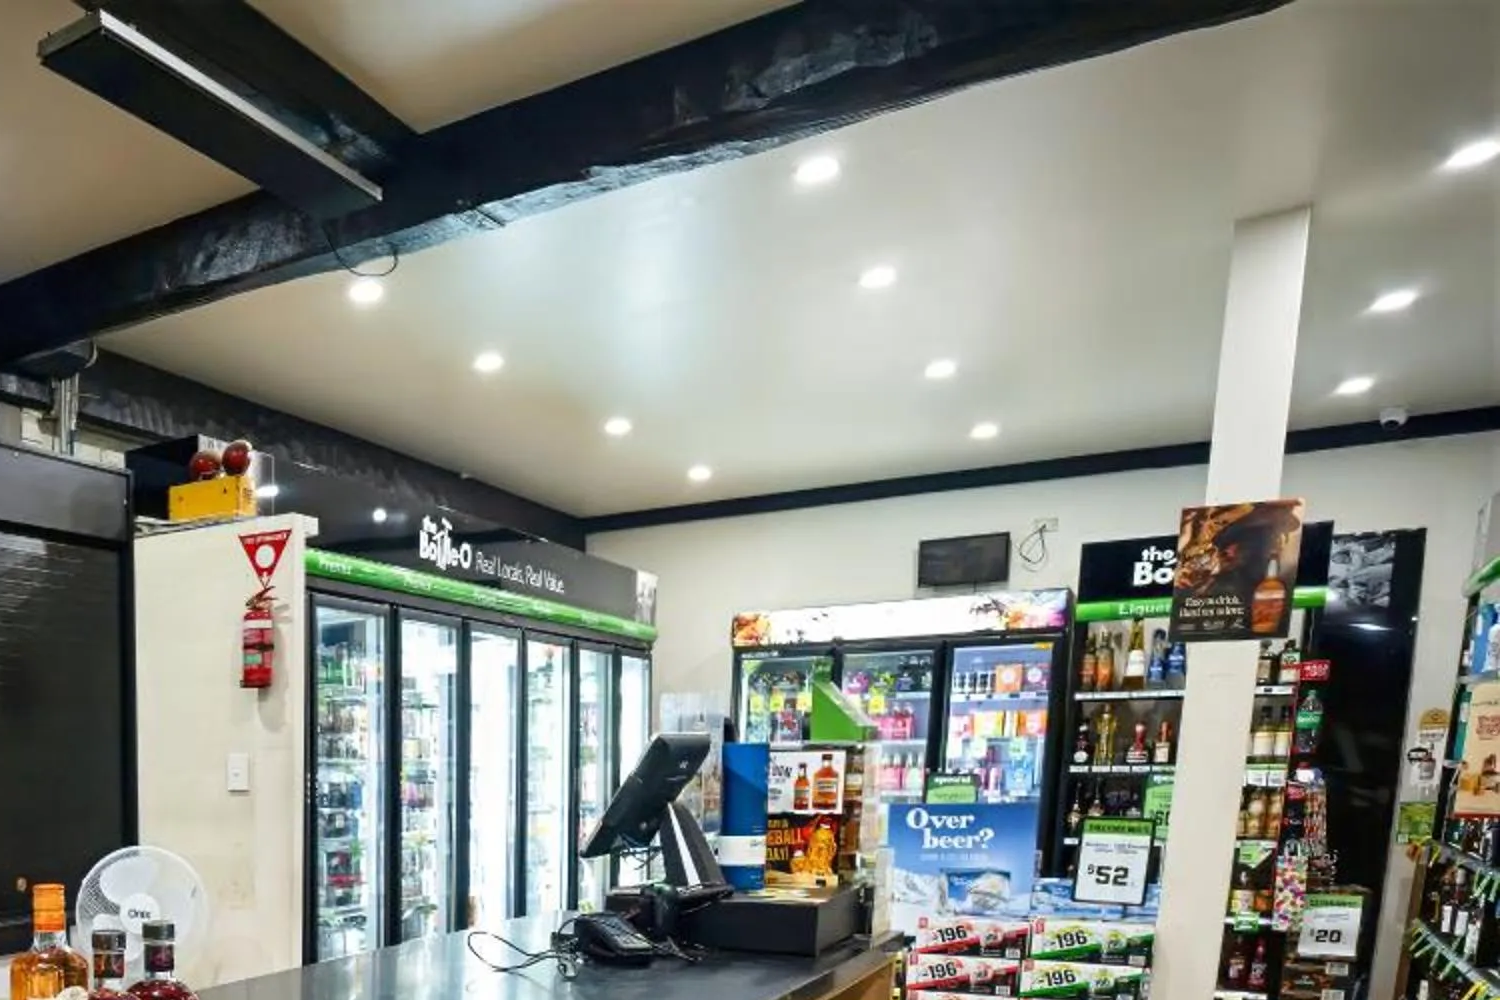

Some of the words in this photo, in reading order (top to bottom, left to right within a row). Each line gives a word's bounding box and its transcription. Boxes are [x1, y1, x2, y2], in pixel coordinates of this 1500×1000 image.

[1142, 546, 1175, 561] the
[907, 807, 974, 829] Over
[922, 827, 994, 849] beer?
[1087, 864, 1129, 887] $52
[1050, 930, 1088, 949] -196
[1038, 969, 1077, 986] -196
